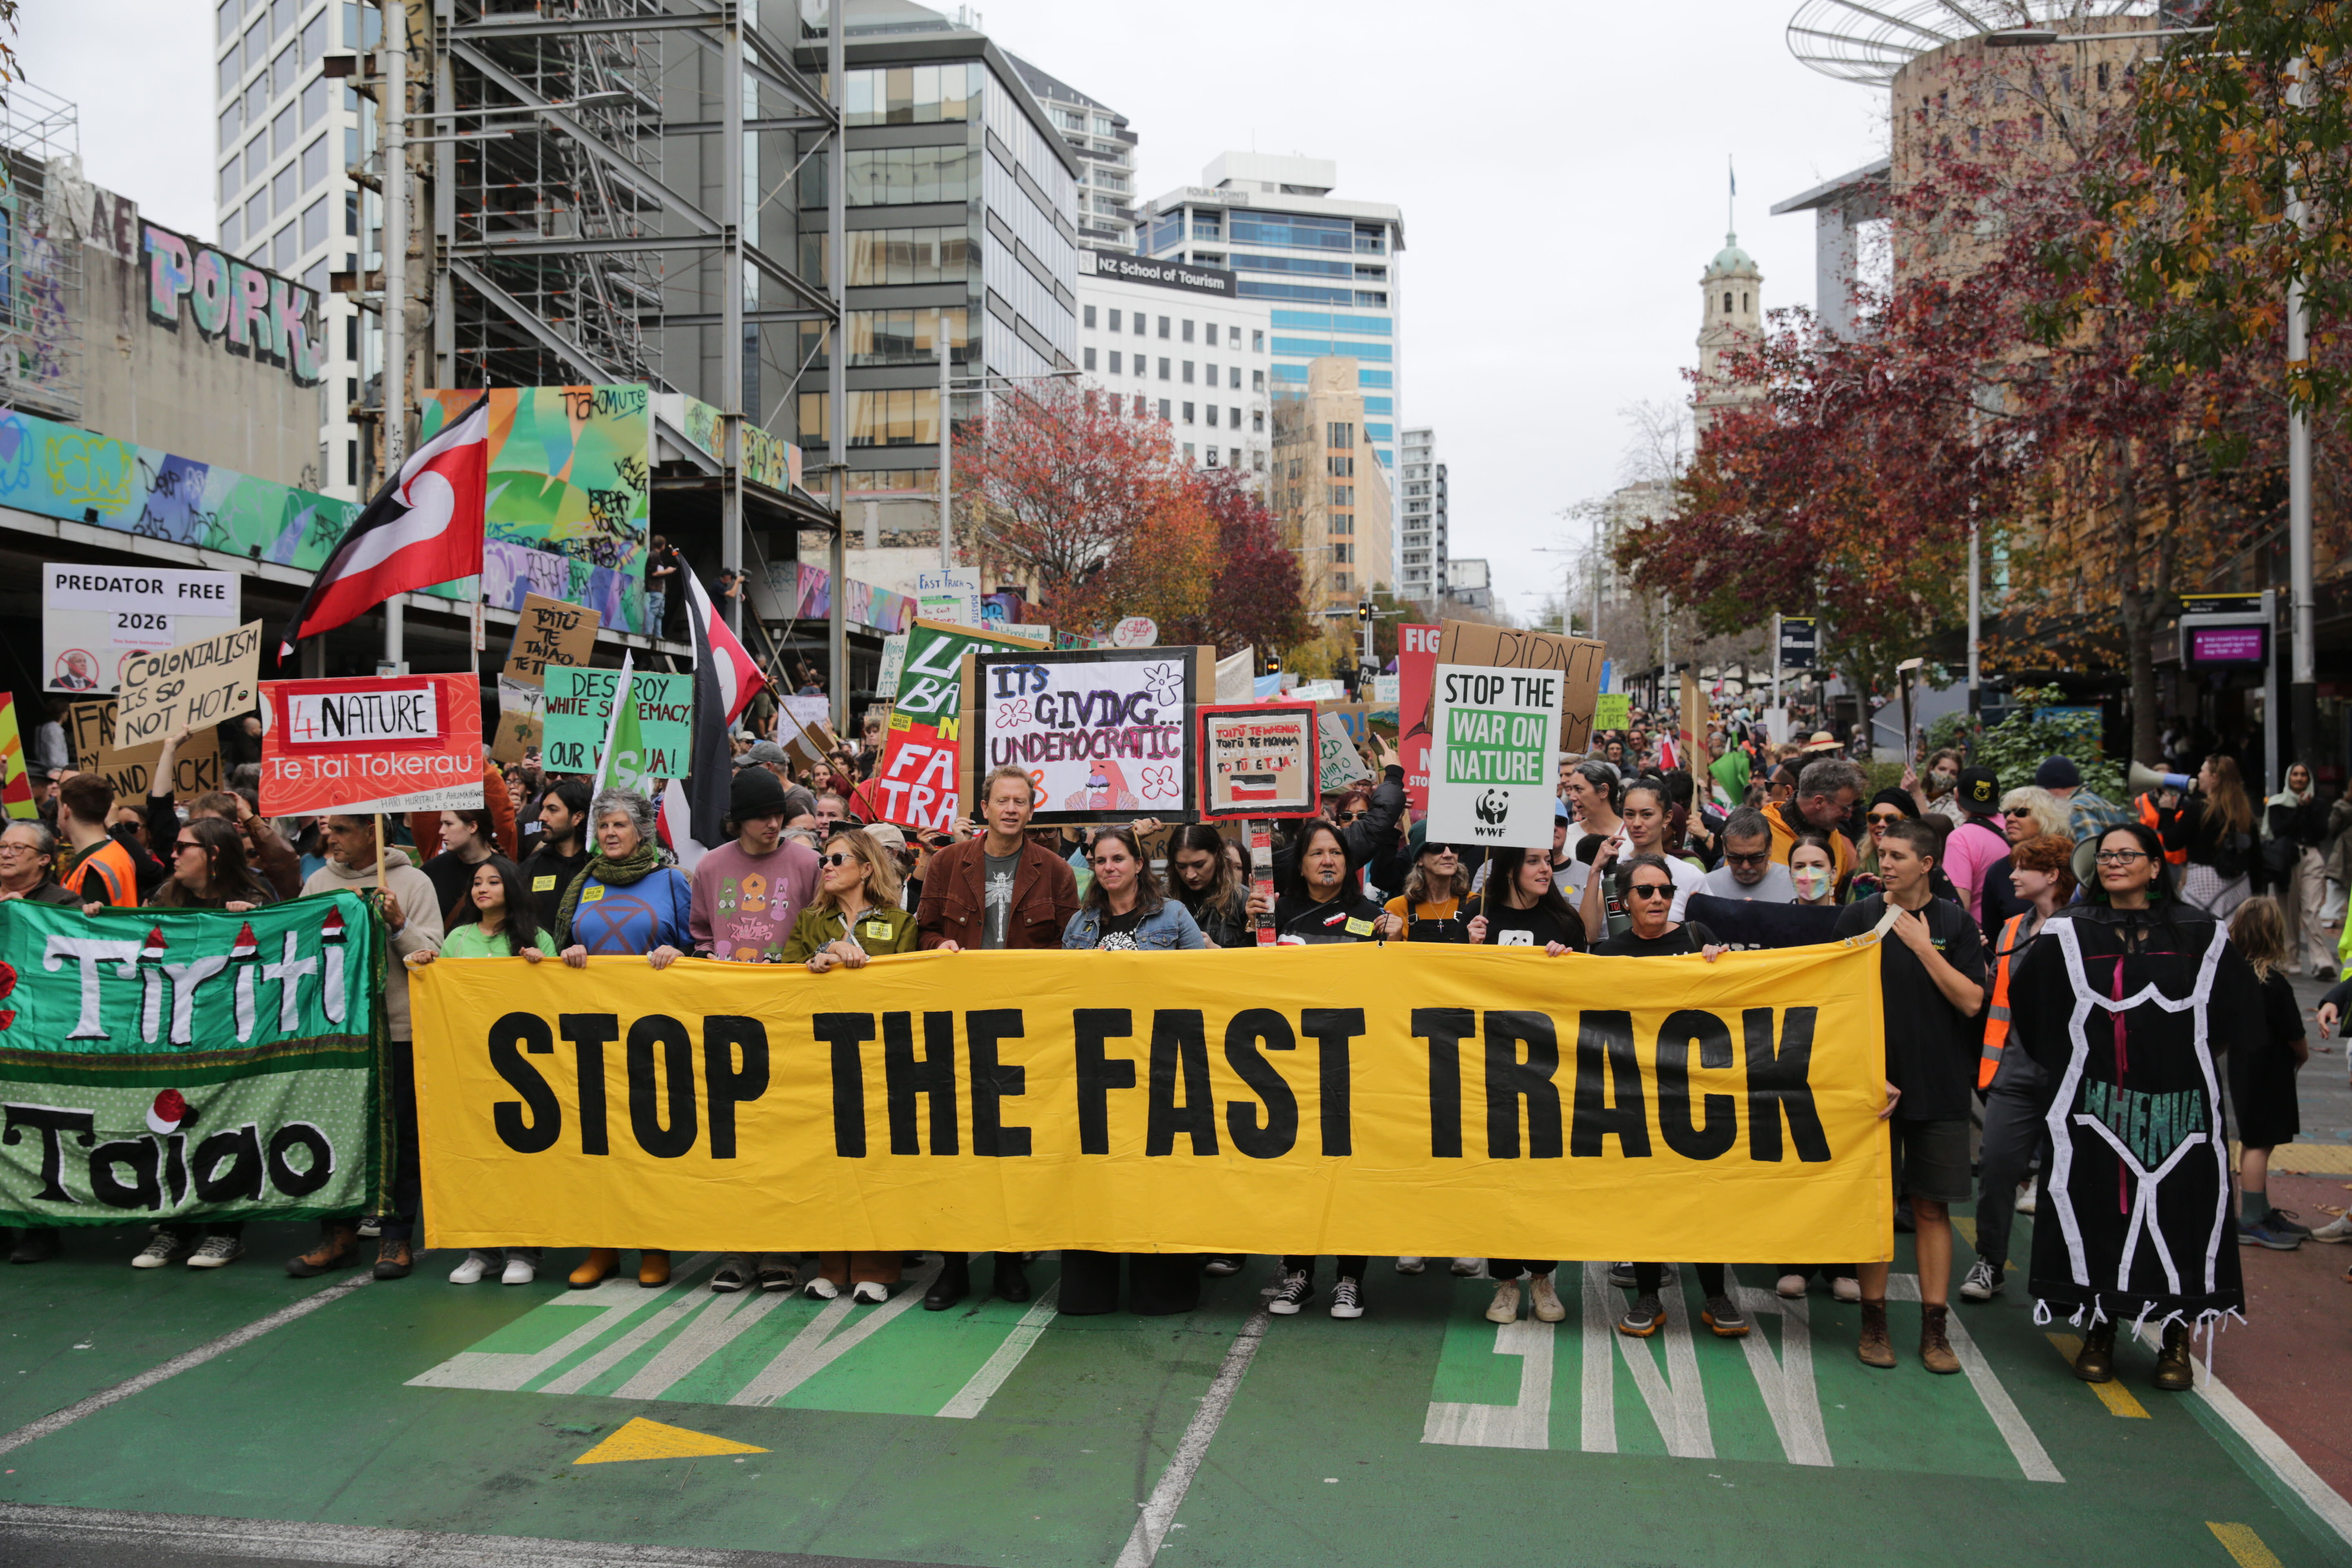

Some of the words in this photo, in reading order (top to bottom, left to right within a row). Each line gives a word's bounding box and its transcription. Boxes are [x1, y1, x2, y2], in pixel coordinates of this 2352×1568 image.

[1098, 258, 1117, 273] NZ
[1120, 261, 1160, 280] School
[1163, 268, 1176, 282] of
[1178, 270, 1225, 290] Tourism
[144, 225, 321, 387] PORK
[56, 574, 164, 594] PREDATOR
[179, 583, 225, 599] FREE
[920, 574, 941, 589] FAST
[941, 570, 964, 588] TRACK
[118, 613, 167, 630] 2026
[971, 595, 979, 624] DISASTER
[533, 625, 562, 646] TE
[1028, 628, 1045, 639] parks
[1059, 632, 1074, 649] STOP
[126, 629, 257, 687] COLONIALISM
[512, 657, 530, 670] TE
[884, 640, 905, 660] Mining
[1452, 625, 1460, 663] I
[1493, 632, 1602, 682] DIDN'T
[572, 673, 670, 702] DESROY
[884, 668, 894, 679] the
[991, 664, 1050, 699] ITS
[120, 688, 148, 715] IS
[156, 679, 185, 703] SO
[1444, 673, 1504, 705] STOP
[1511, 677, 1555, 708] THE
[322, 695, 427, 737] NATURE
[545, 696, 590, 716] WHITE
[870, 705, 893, 716] FAST
[126, 704, 178, 745] NOT
[1452, 711, 1506, 745] WAR
[1512, 716, 1544, 749] ON
[550, 742, 585, 768] OUR
[991, 725, 1181, 766] UNDEMOCRATIC
[1247, 737, 1261, 748] TE
[1263, 736, 1299, 746] MOANA
[80, 751, 99, 773] MY
[269, 757, 302, 780] Te
[307, 754, 348, 779] Tai
[355, 752, 472, 776] Tokerau
[1450, 750, 1539, 781] NATURE
[1410, 775, 1429, 787] STO
[381, 796, 401, 808] HARI
[435, 792, 443, 801] TE
[1474, 826, 1506, 837] WWF
[42, 904, 348, 1046] Tiriti
[488, 1011, 770, 1160] STOP
[815, 1008, 1033, 1158] THE
[1073, 1007, 1367, 1159] FAST
[1410, 1005, 1833, 1164] TRACK
[2084, 1077, 2206, 1167] WHENUA
[1, 1088, 336, 1212] Taiao
